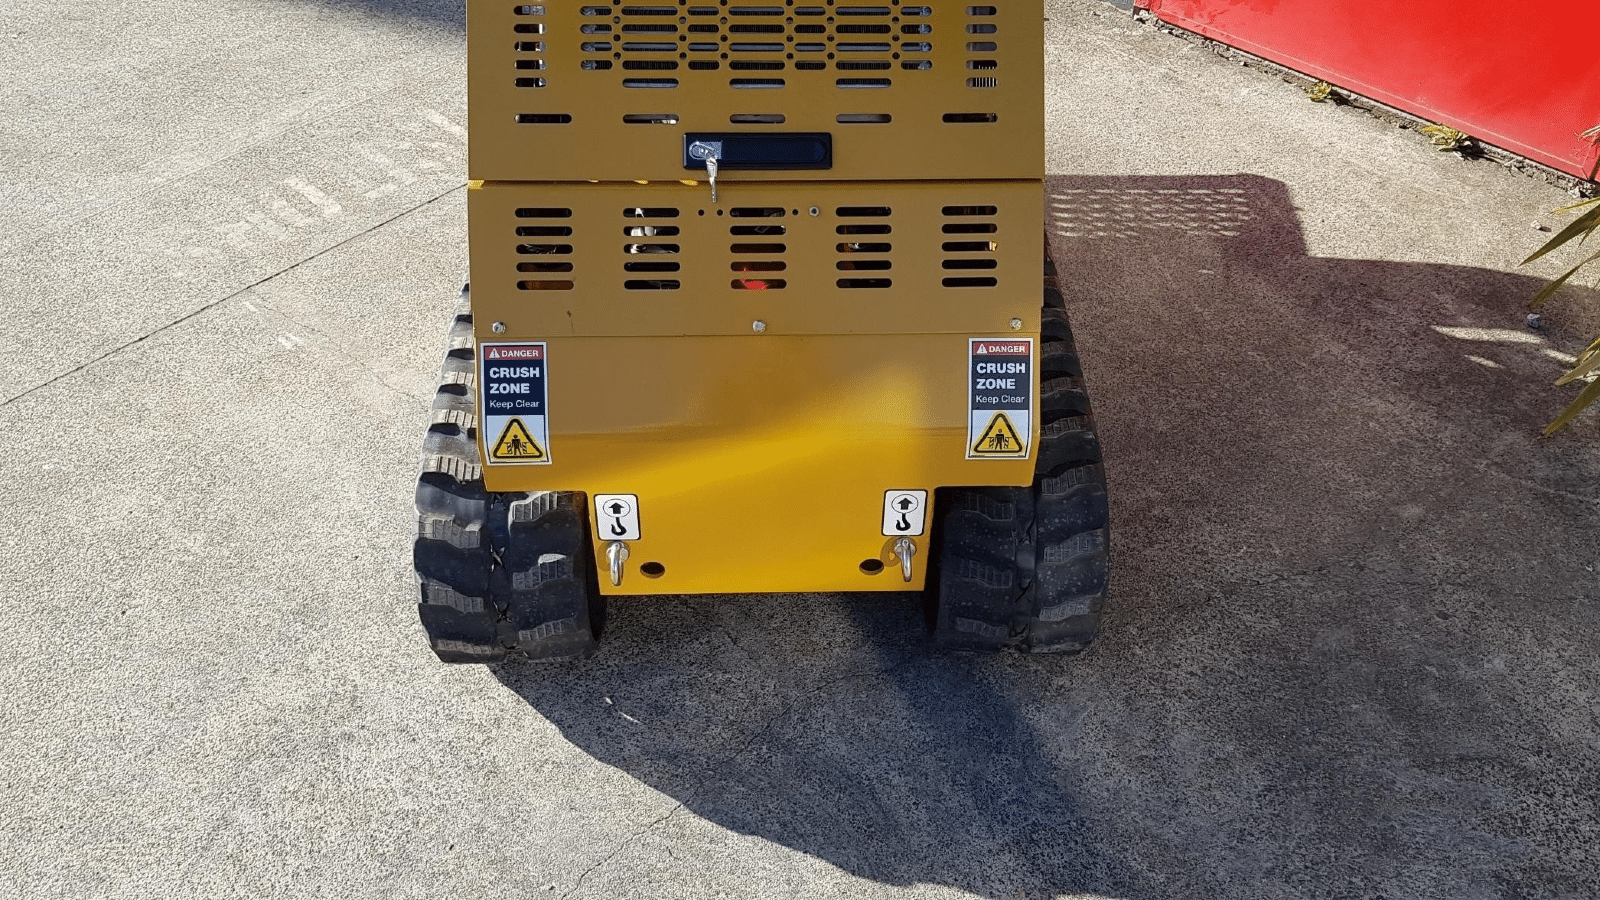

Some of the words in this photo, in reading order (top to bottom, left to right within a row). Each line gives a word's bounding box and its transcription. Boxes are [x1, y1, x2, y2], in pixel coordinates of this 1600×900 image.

[501, 349, 539, 358] DANGER
[988, 345, 1026, 353] DANGER
[489, 366, 540, 378] CRUSH
[976, 362, 1026, 374] CRUSH
[489, 383, 530, 394] ZONE
[976, 378, 1016, 390] ZONE
[489, 400, 513, 409] Keep
[515, 400, 540, 408] Clear
[975, 395, 999, 404] Keep
[1001, 395, 1025, 403] Clear
